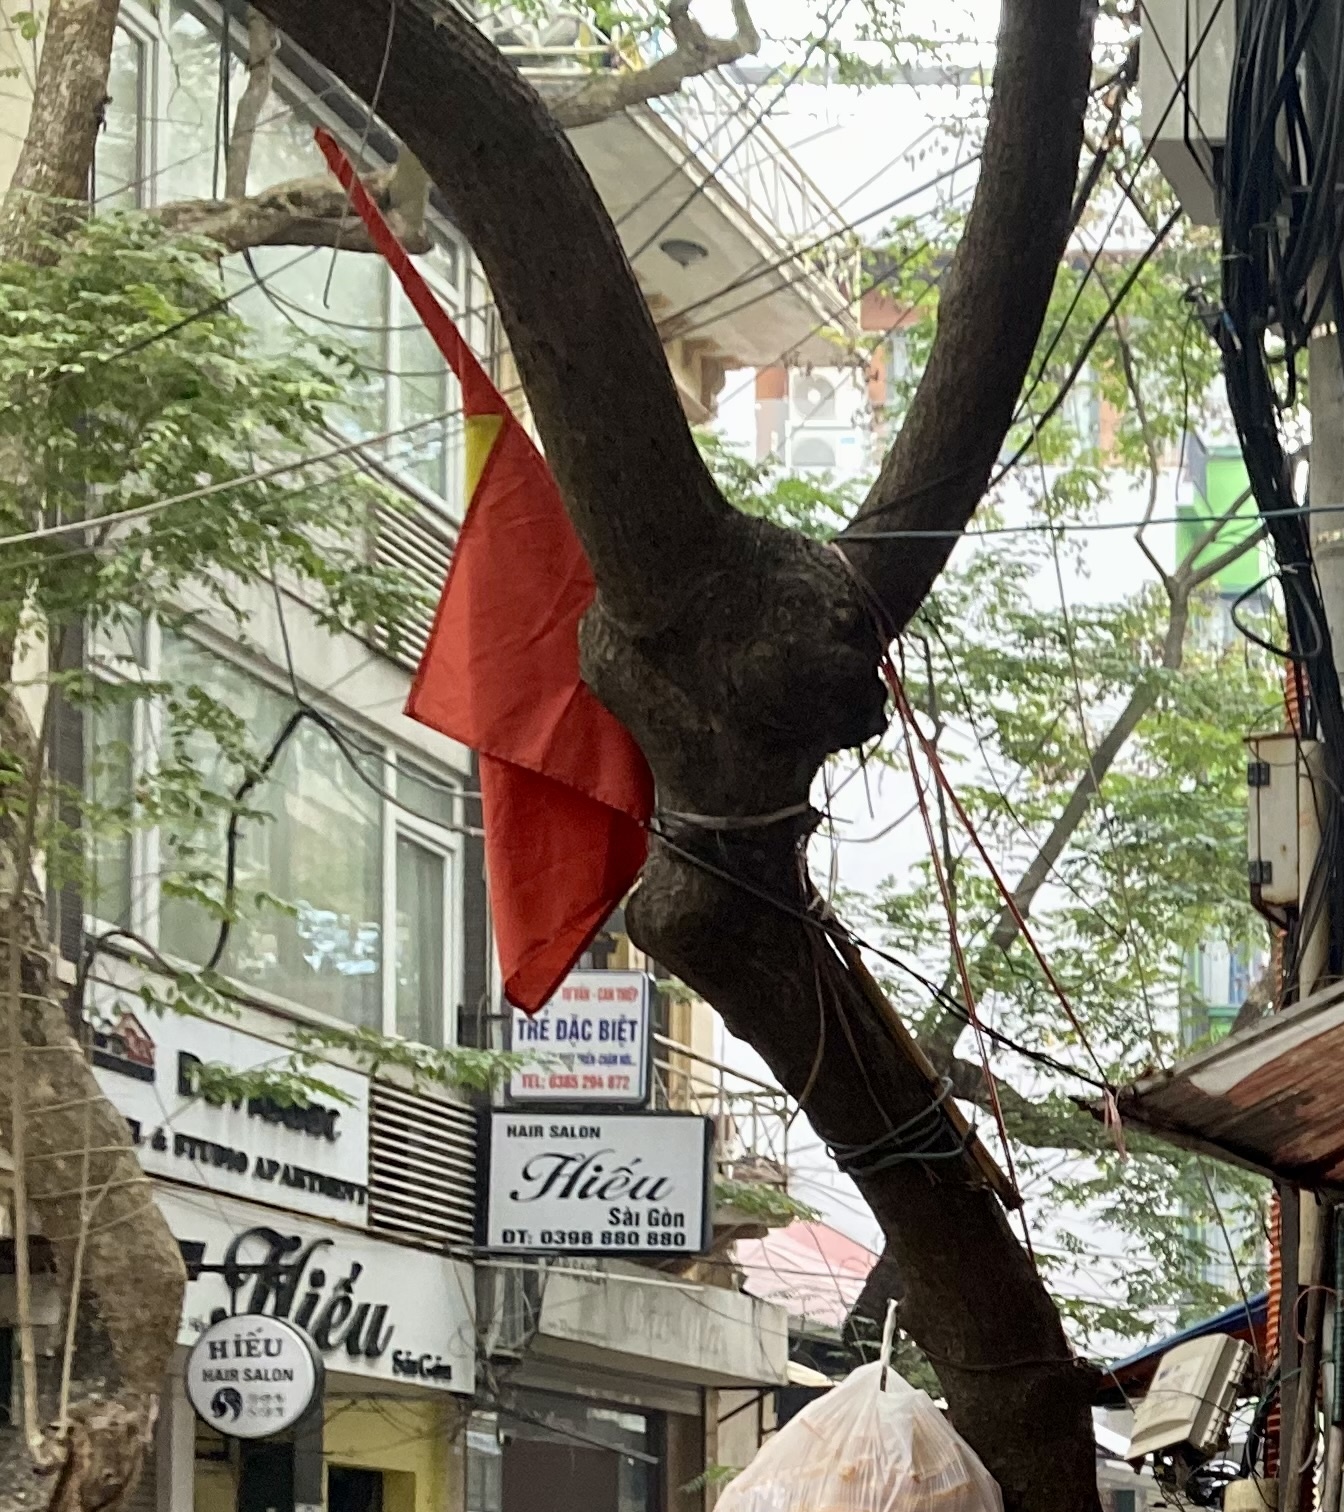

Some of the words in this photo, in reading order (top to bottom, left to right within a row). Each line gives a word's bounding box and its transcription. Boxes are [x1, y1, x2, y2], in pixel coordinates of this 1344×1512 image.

[556, 1014, 592, 1047] ĐẶC
[599, 1015, 638, 1047] BIỆT
[522, 1073, 545, 1088] TEL:
[506, 1125, 544, 1138] HAIR
[550, 1125, 601, 1139] SALON
[509, 1148, 675, 1202] Hiếu
[608, 1207, 640, 1228] Sài
[647, 1207, 684, 1228] Gòn
[540, 1230, 592, 1245] 0398
[601, 1231, 639, 1245] 880
[647, 1231, 686, 1246] 880
[208, 1327, 283, 1361] HIẾU
[202, 1365, 240, 1383] HAIR
[243, 1366, 294, 1383] SALON
